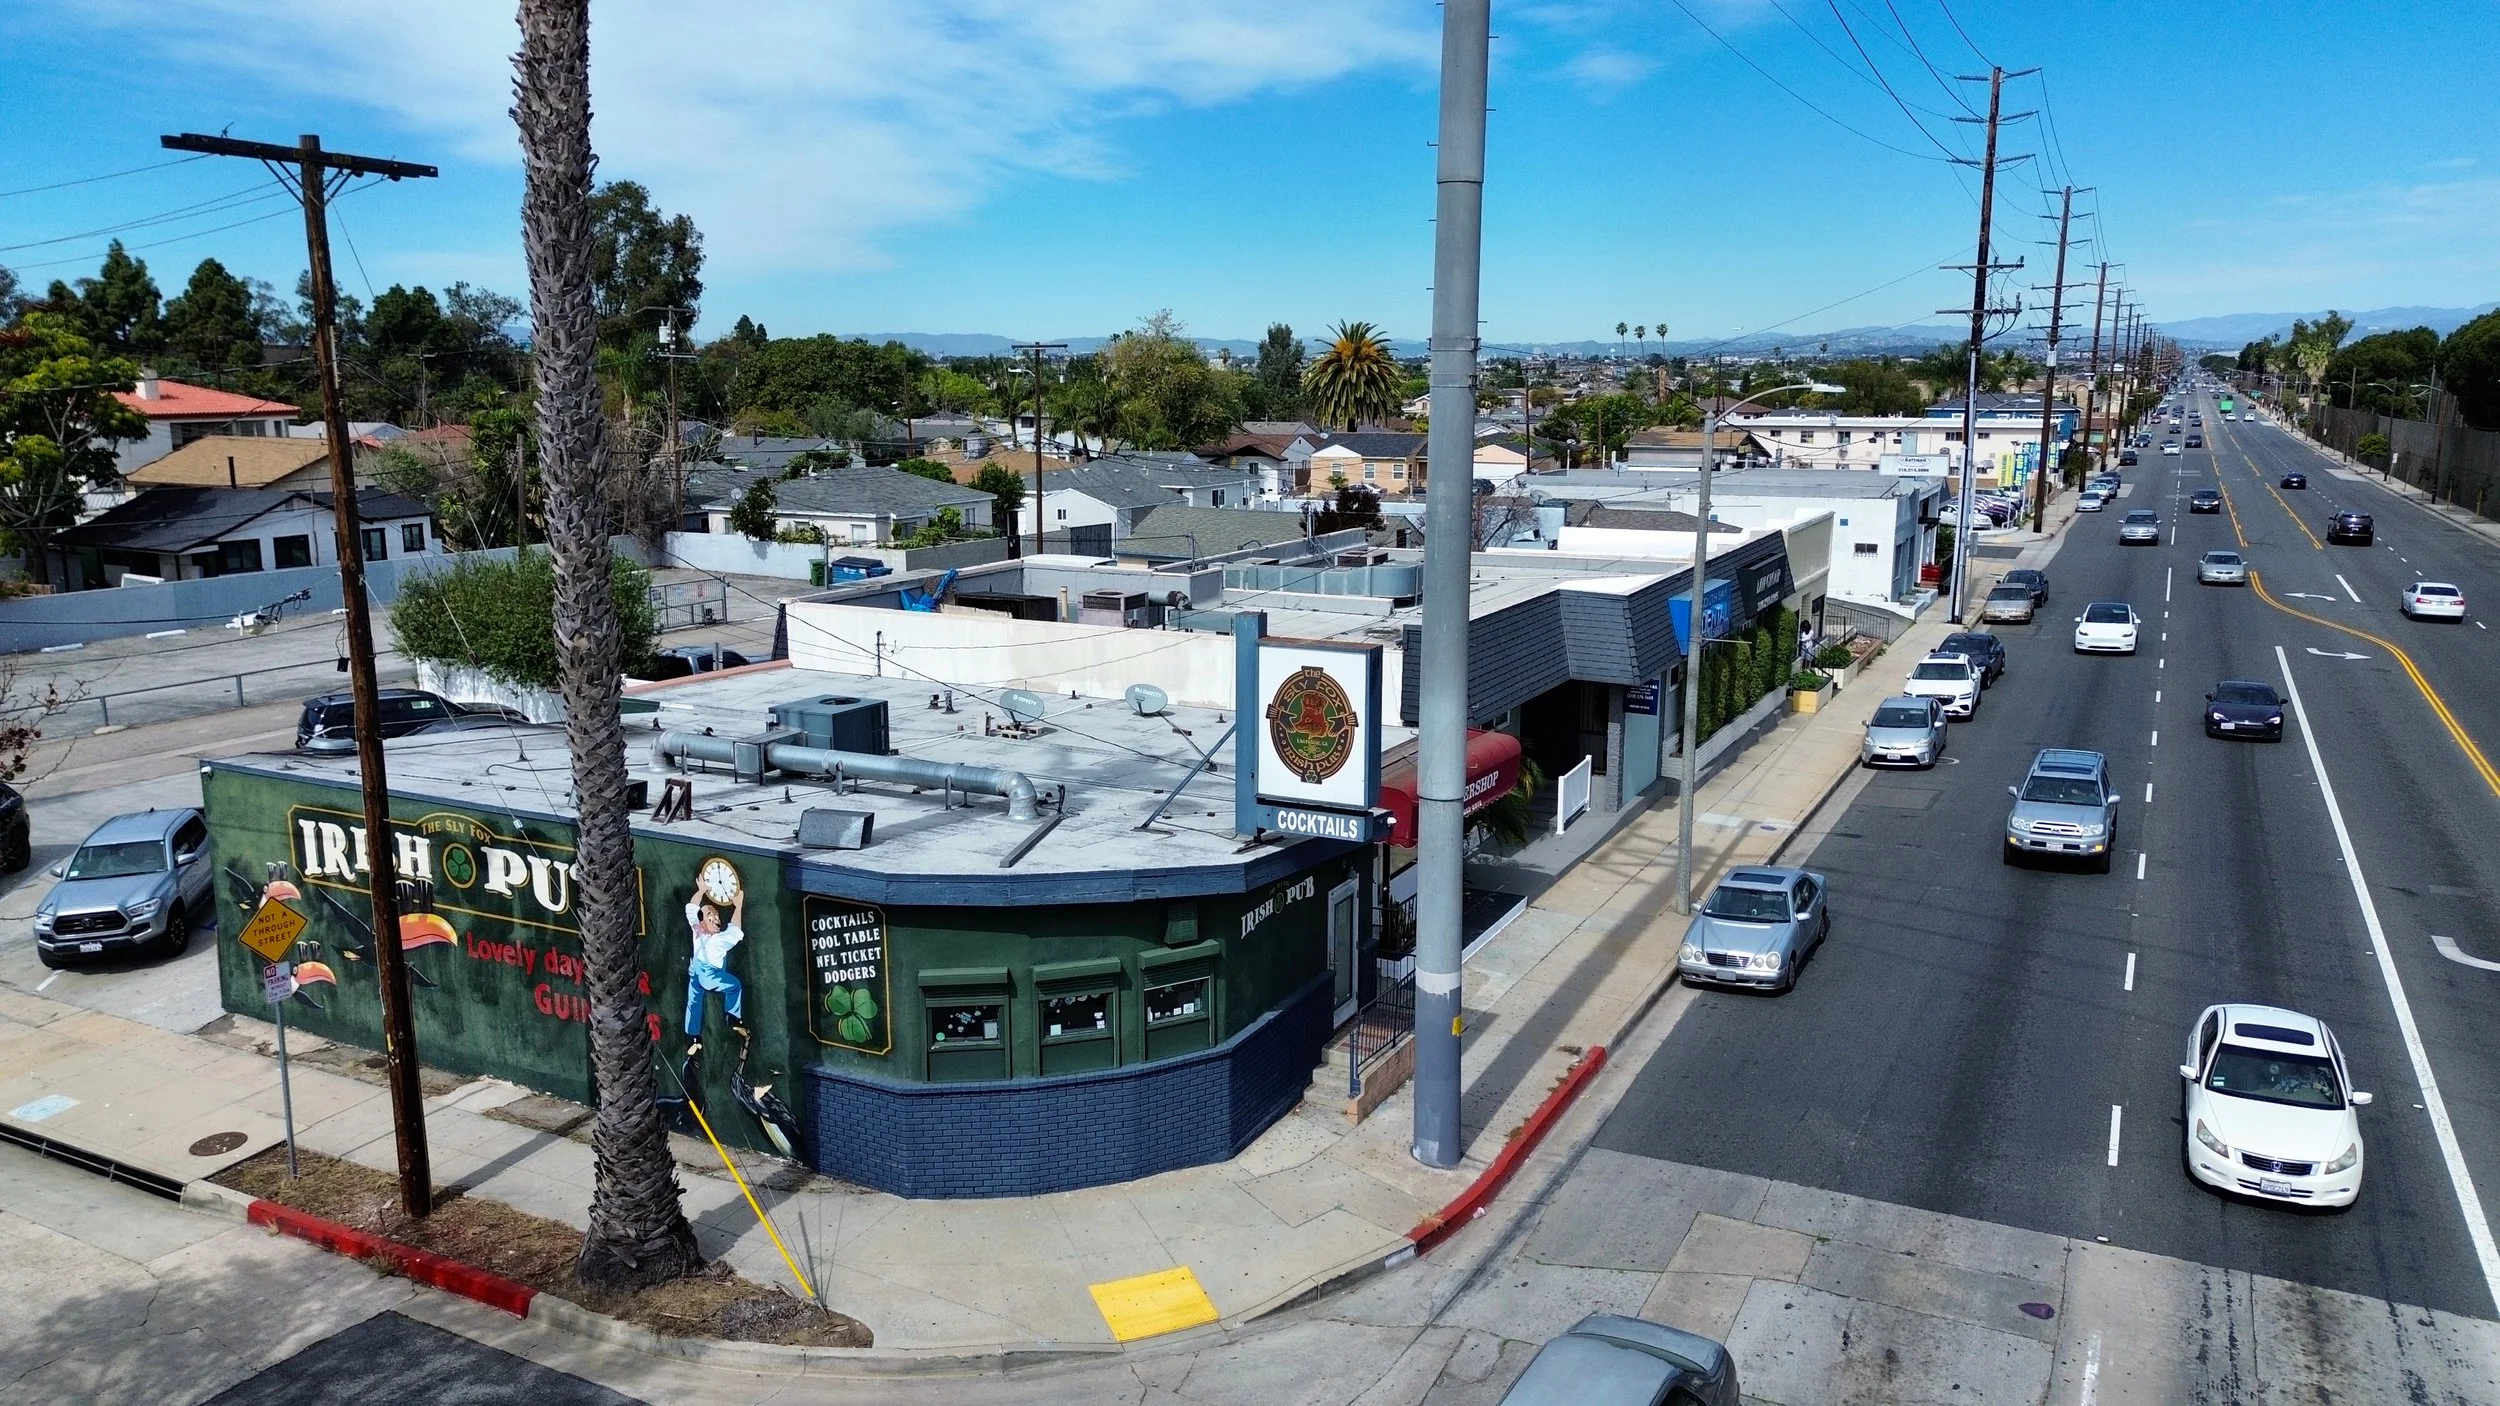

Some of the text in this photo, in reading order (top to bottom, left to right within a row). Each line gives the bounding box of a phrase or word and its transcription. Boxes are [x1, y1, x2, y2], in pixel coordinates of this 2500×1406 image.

[1283, 680, 1343, 707] SLY FOX
[420, 819, 492, 845] THE SLY FOX
[1277, 810, 1358, 839] COCKTAILS
[298, 819, 579, 914] IRIH PU
[258, 911, 288, 925] NOT A
[1240, 898, 1274, 940] IRISH
[1285, 875, 1315, 905] PUB
[253, 919, 296, 936] THROUGH
[811, 910, 875, 932] COCKTAILS
[258, 931, 292, 947] STREET
[811, 928, 881, 951] POOL TABLE
[466, 931, 537, 976] Lovely
[543, 946, 586, 986] day
[816, 947, 882, 969] NFL TICKET
[266, 966, 276, 978] NO
[824, 965, 877, 984] DODGERS
